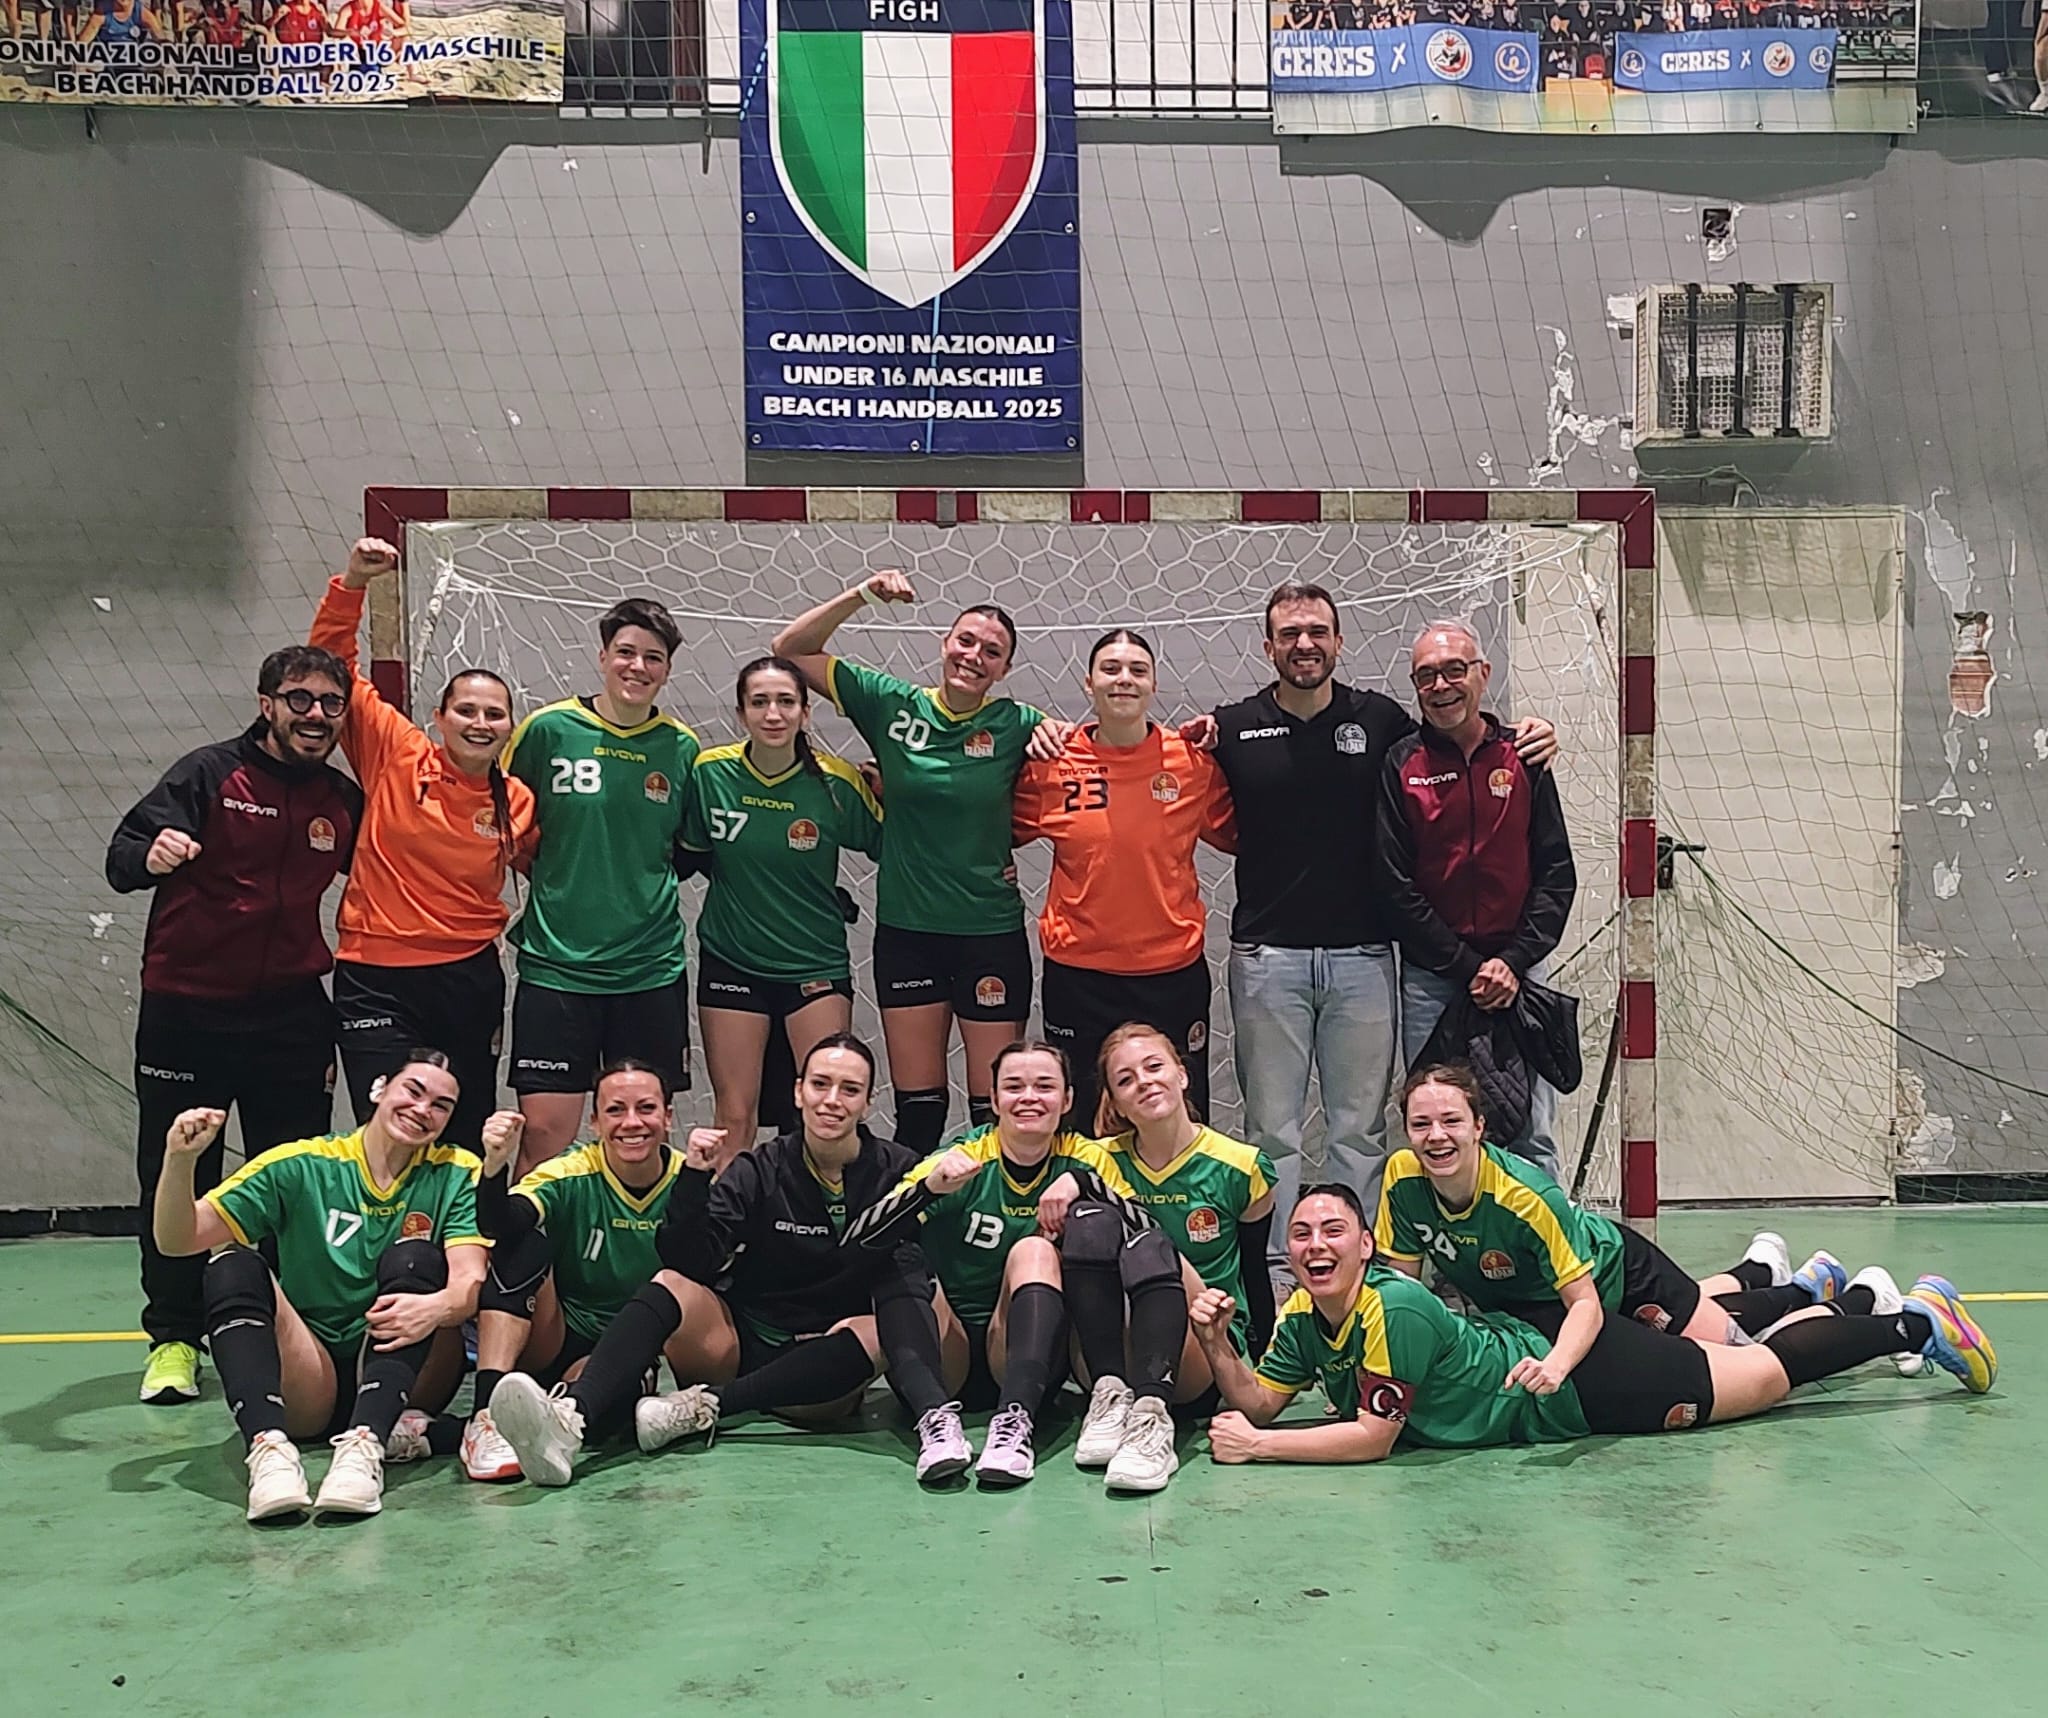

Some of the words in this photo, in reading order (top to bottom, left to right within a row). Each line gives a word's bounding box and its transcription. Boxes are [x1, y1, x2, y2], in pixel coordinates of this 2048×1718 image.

[869, 1, 939, 22] FIGH
[64, 43, 232, 66] NAZIONALI
[260, 43, 356, 66] UNDER
[365, 42, 393, 64] 16
[403, 37, 544, 62] MASCHILE
[1272, 45, 1376, 78] CERES
[1661, 49, 1731, 74] CERES
[58, 72, 157, 95] BEACH
[168, 73, 323, 97] HANDBALL
[331, 74, 396, 94] 2025
[769, 333, 905, 354] CAMPIONI
[911, 335, 1056, 355] NAZIONALI
[783, 365, 876, 386] UNDER
[882, 367, 907, 386] 16
[912, 366, 1044, 387] MASCHILE
[763, 396, 852, 417] BEACH
[857, 397, 999, 419] HANDBALL
[1004, 398, 1063, 418] 2025
[888, 709, 930, 749] 20
[550, 757, 602, 794] 28
[1062, 779, 1109, 814] 23
[709, 807, 749, 842] 57
[325, 1207, 363, 1247] 17
[964, 1211, 1005, 1250] 13
